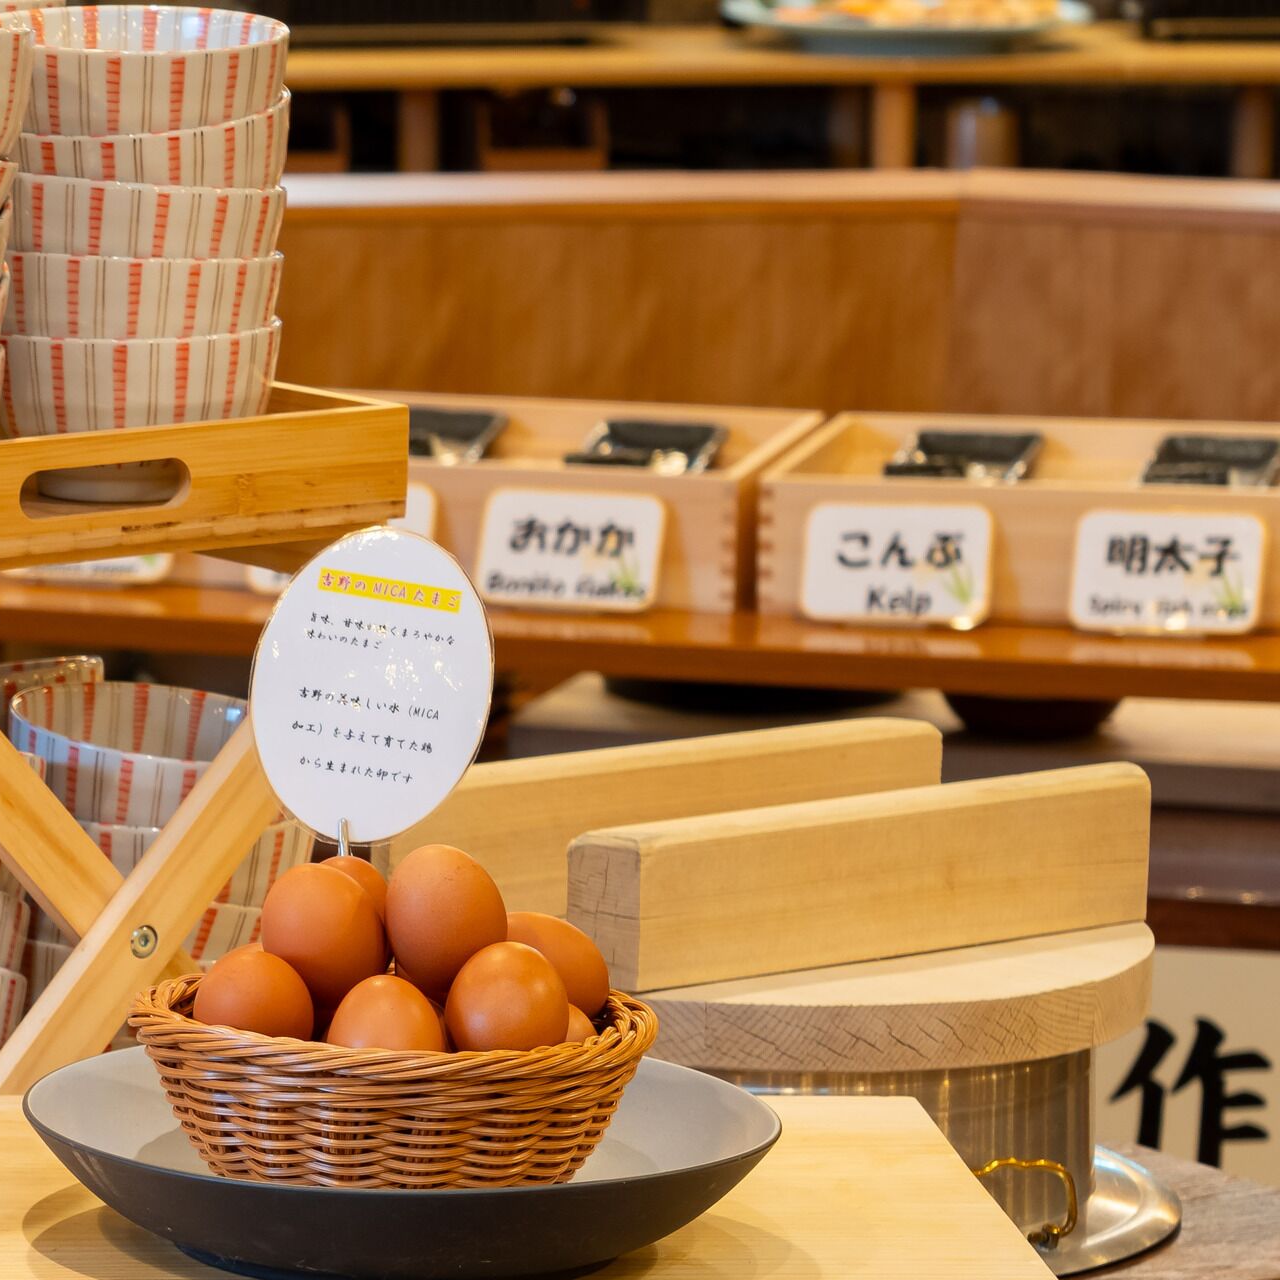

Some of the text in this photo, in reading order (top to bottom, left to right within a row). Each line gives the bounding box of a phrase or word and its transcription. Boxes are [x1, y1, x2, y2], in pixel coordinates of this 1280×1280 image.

[509, 517, 635, 557] おかか
[835, 532, 966, 570] こんぶ
[1106, 534, 1238, 575] 明太子
[866, 586, 932, 616] Kelp
[298, 755, 414, 784] から生まれた卵です
[1109, 1015, 1273, 1169] 作
